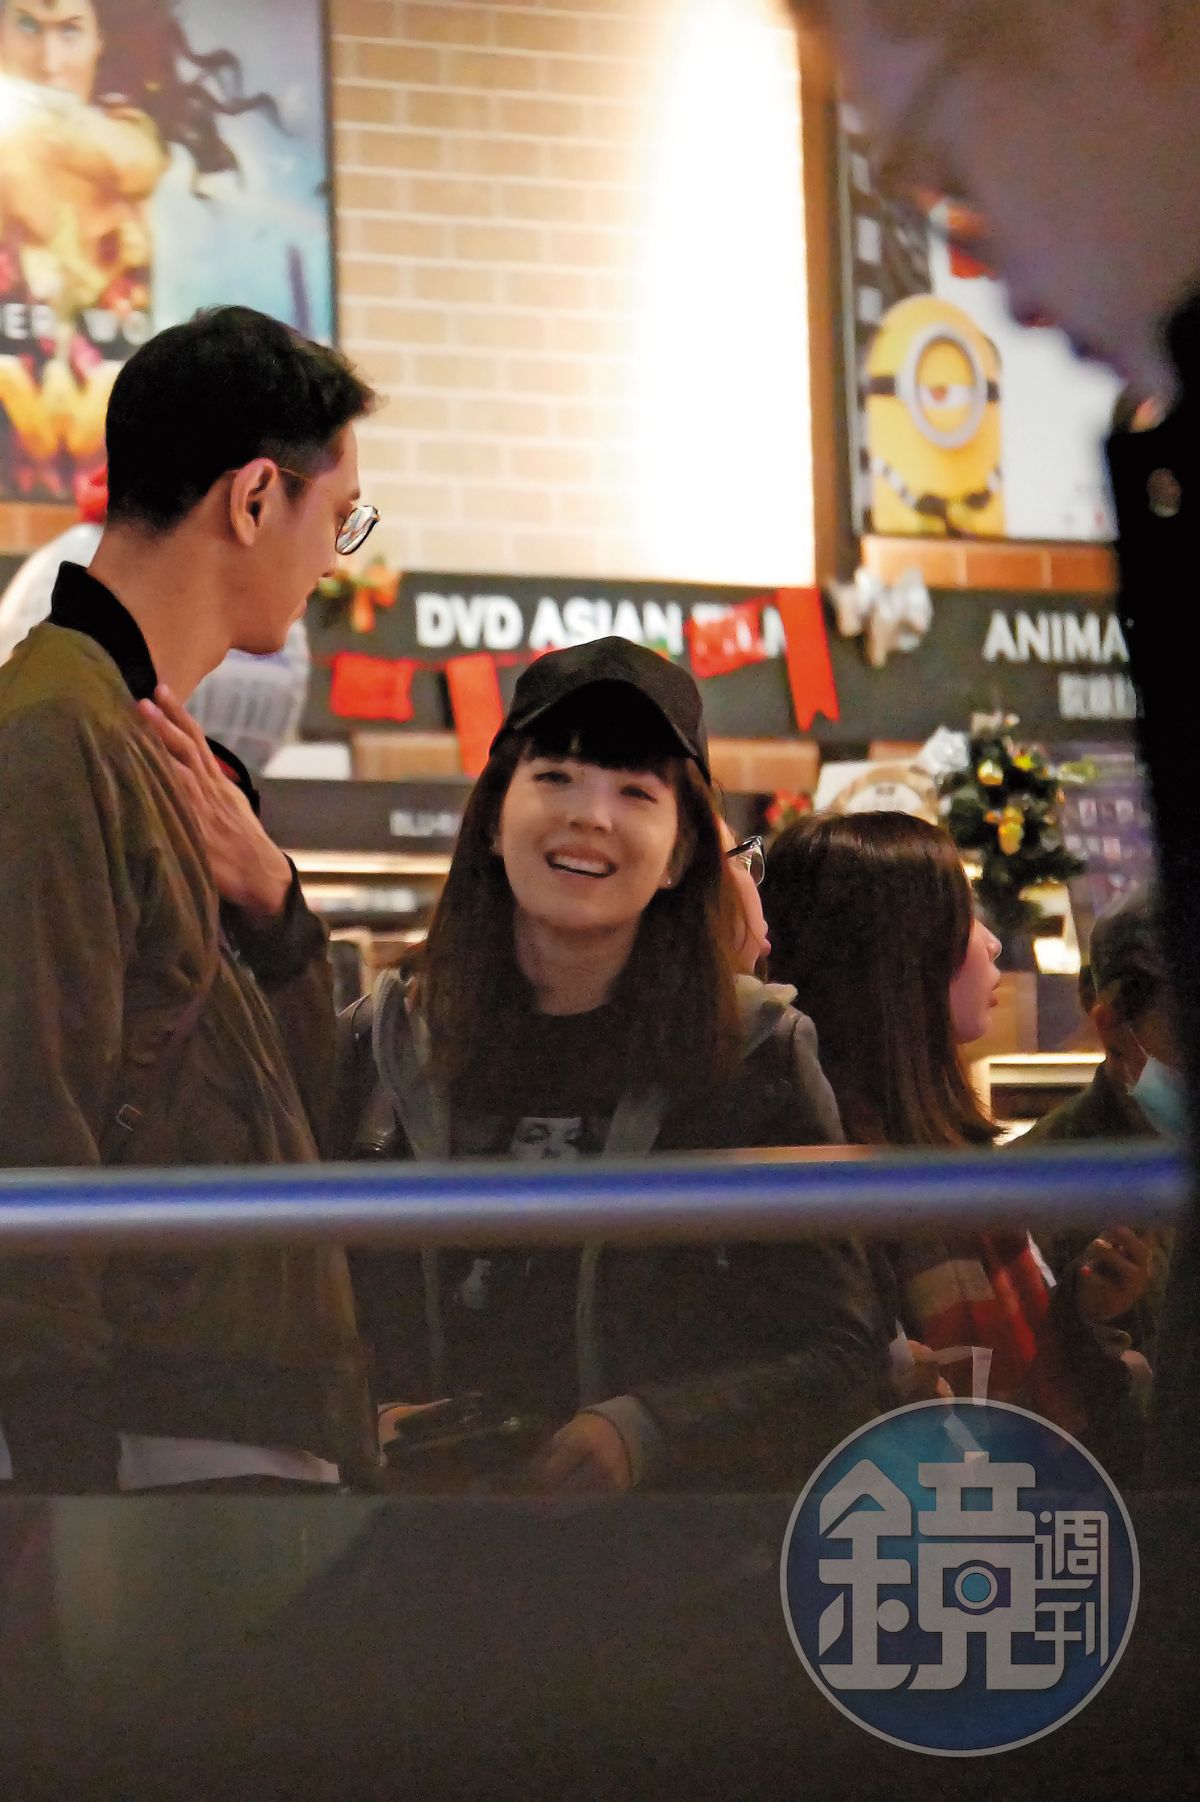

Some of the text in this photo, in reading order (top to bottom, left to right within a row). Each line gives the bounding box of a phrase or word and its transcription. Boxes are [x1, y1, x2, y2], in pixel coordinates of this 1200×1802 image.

[82, 307, 152, 346] WO
[415, 593, 524, 650] DVD
[529, 597, 684, 656] ASIAN
[983, 609, 1131, 663] ANIMA
